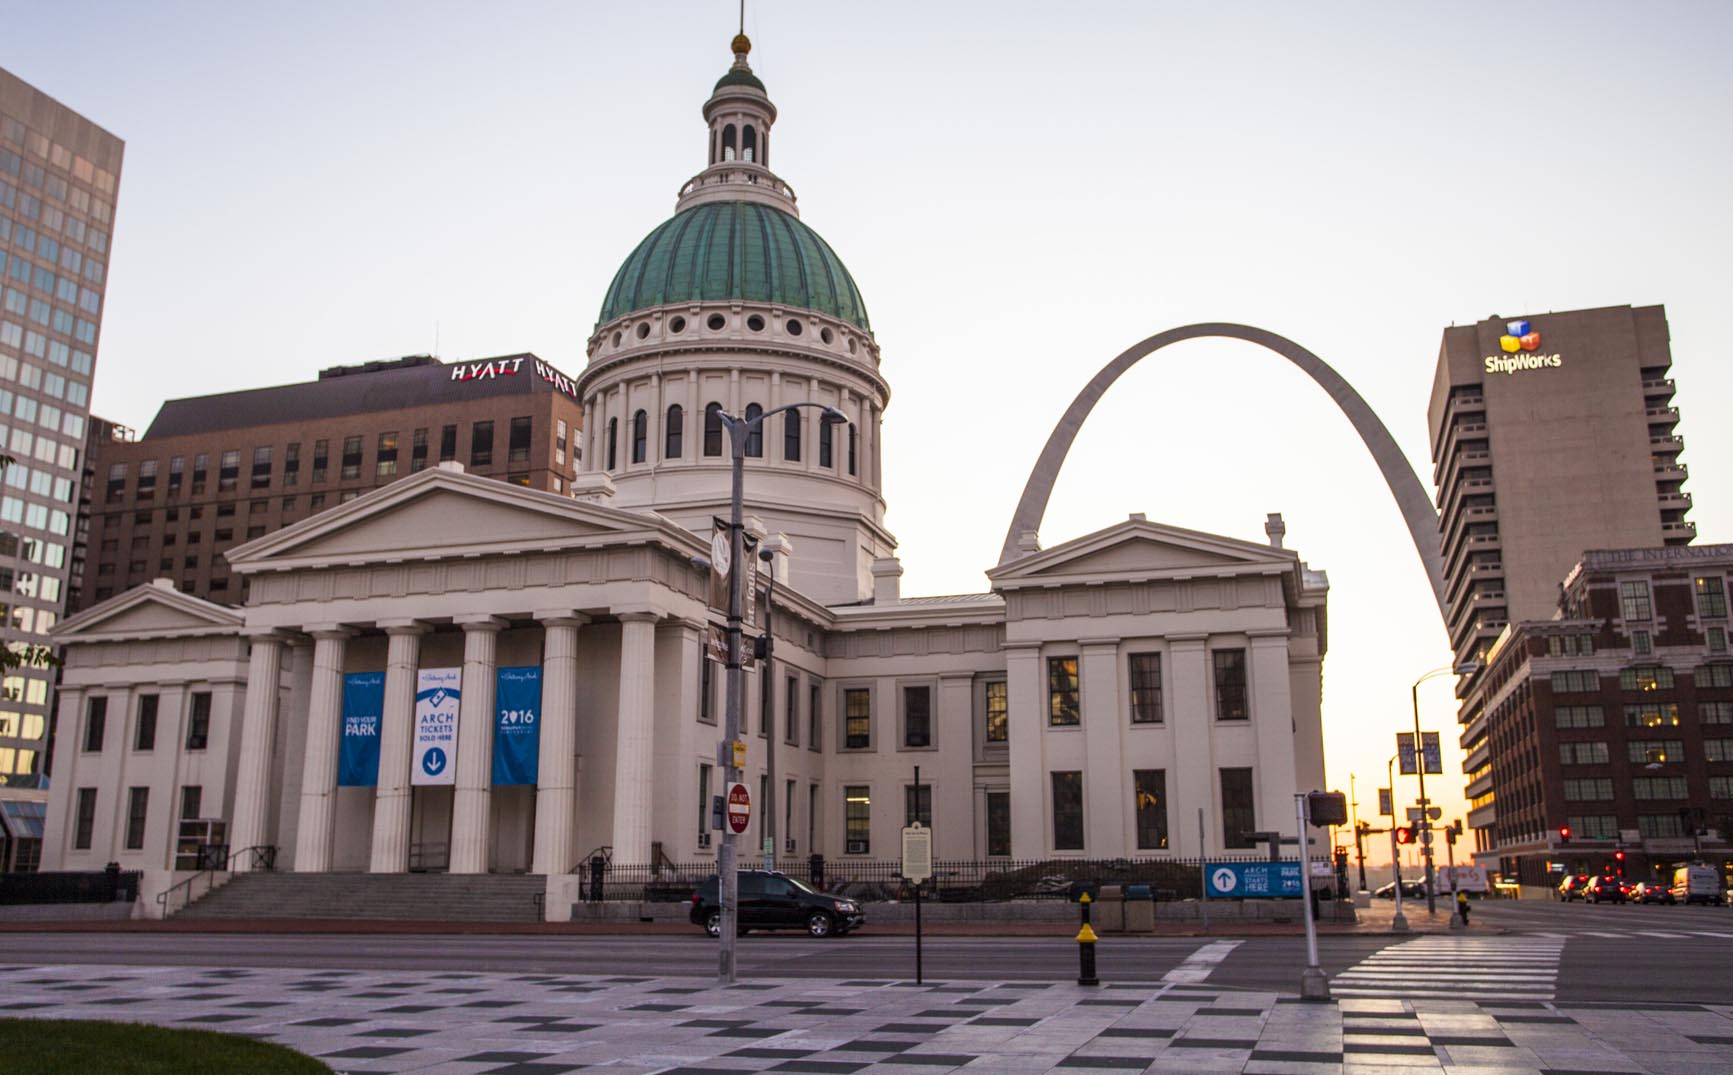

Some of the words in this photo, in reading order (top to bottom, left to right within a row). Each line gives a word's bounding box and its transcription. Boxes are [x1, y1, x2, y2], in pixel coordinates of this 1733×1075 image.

[451, 358, 523, 380] HYATT
[536, 361, 577, 397] HYATT
[421, 713, 454, 723] ARCH
[345, 723, 376, 736] PARK
[420, 725, 453, 733] TICKETS
